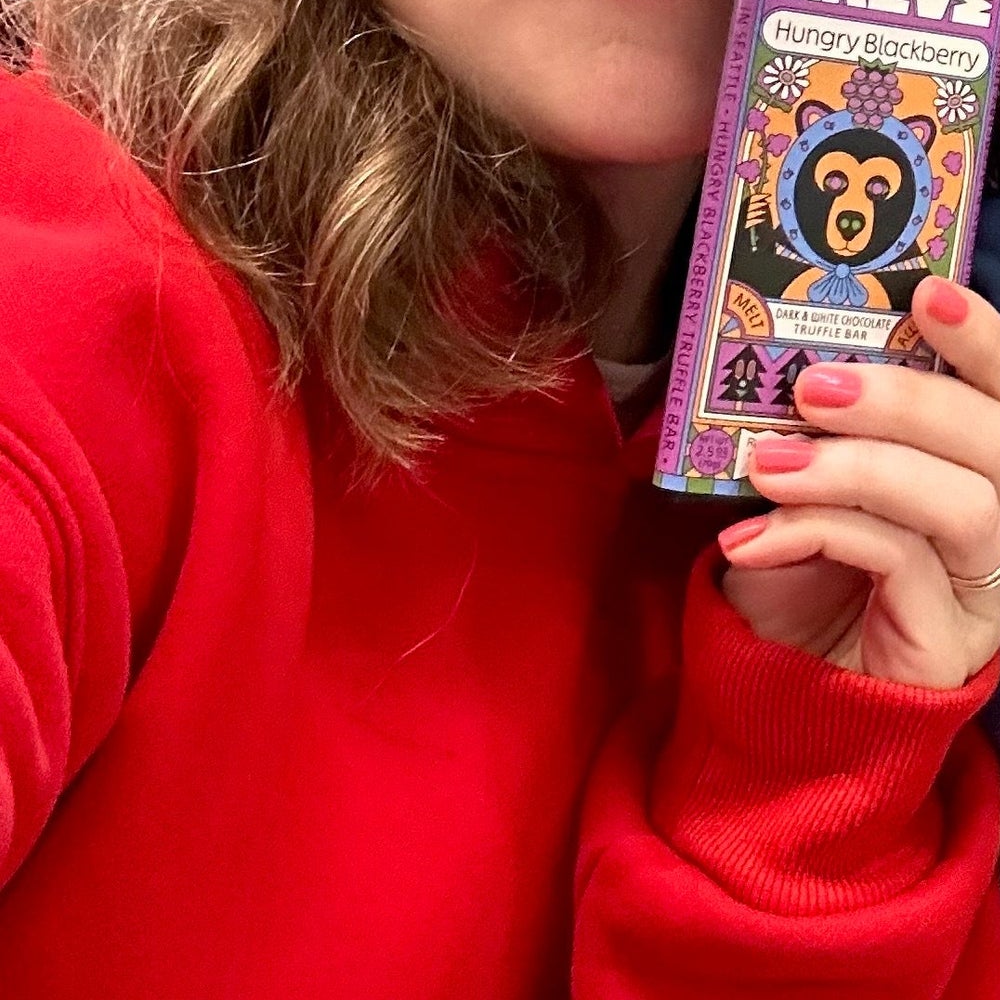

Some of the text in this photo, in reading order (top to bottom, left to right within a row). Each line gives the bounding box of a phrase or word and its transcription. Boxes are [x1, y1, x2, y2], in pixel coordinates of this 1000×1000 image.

[775, 18, 980, 73] Hungry Blackberry
[707, 120, 731, 201] HUNGRY
[687, 207, 715, 323] BLACKBERRY
[734, 291, 765, 330] MELT
[776, 307, 800, 321] DARK
[810, 312, 840, 326] WHITE
[841, 315, 893, 331] CHOCOLATE
[794, 323, 868, 341] TRUFFLE BAR
[669, 331, 694, 408] TRUFFLE
[662, 413, 679, 451] BAR
